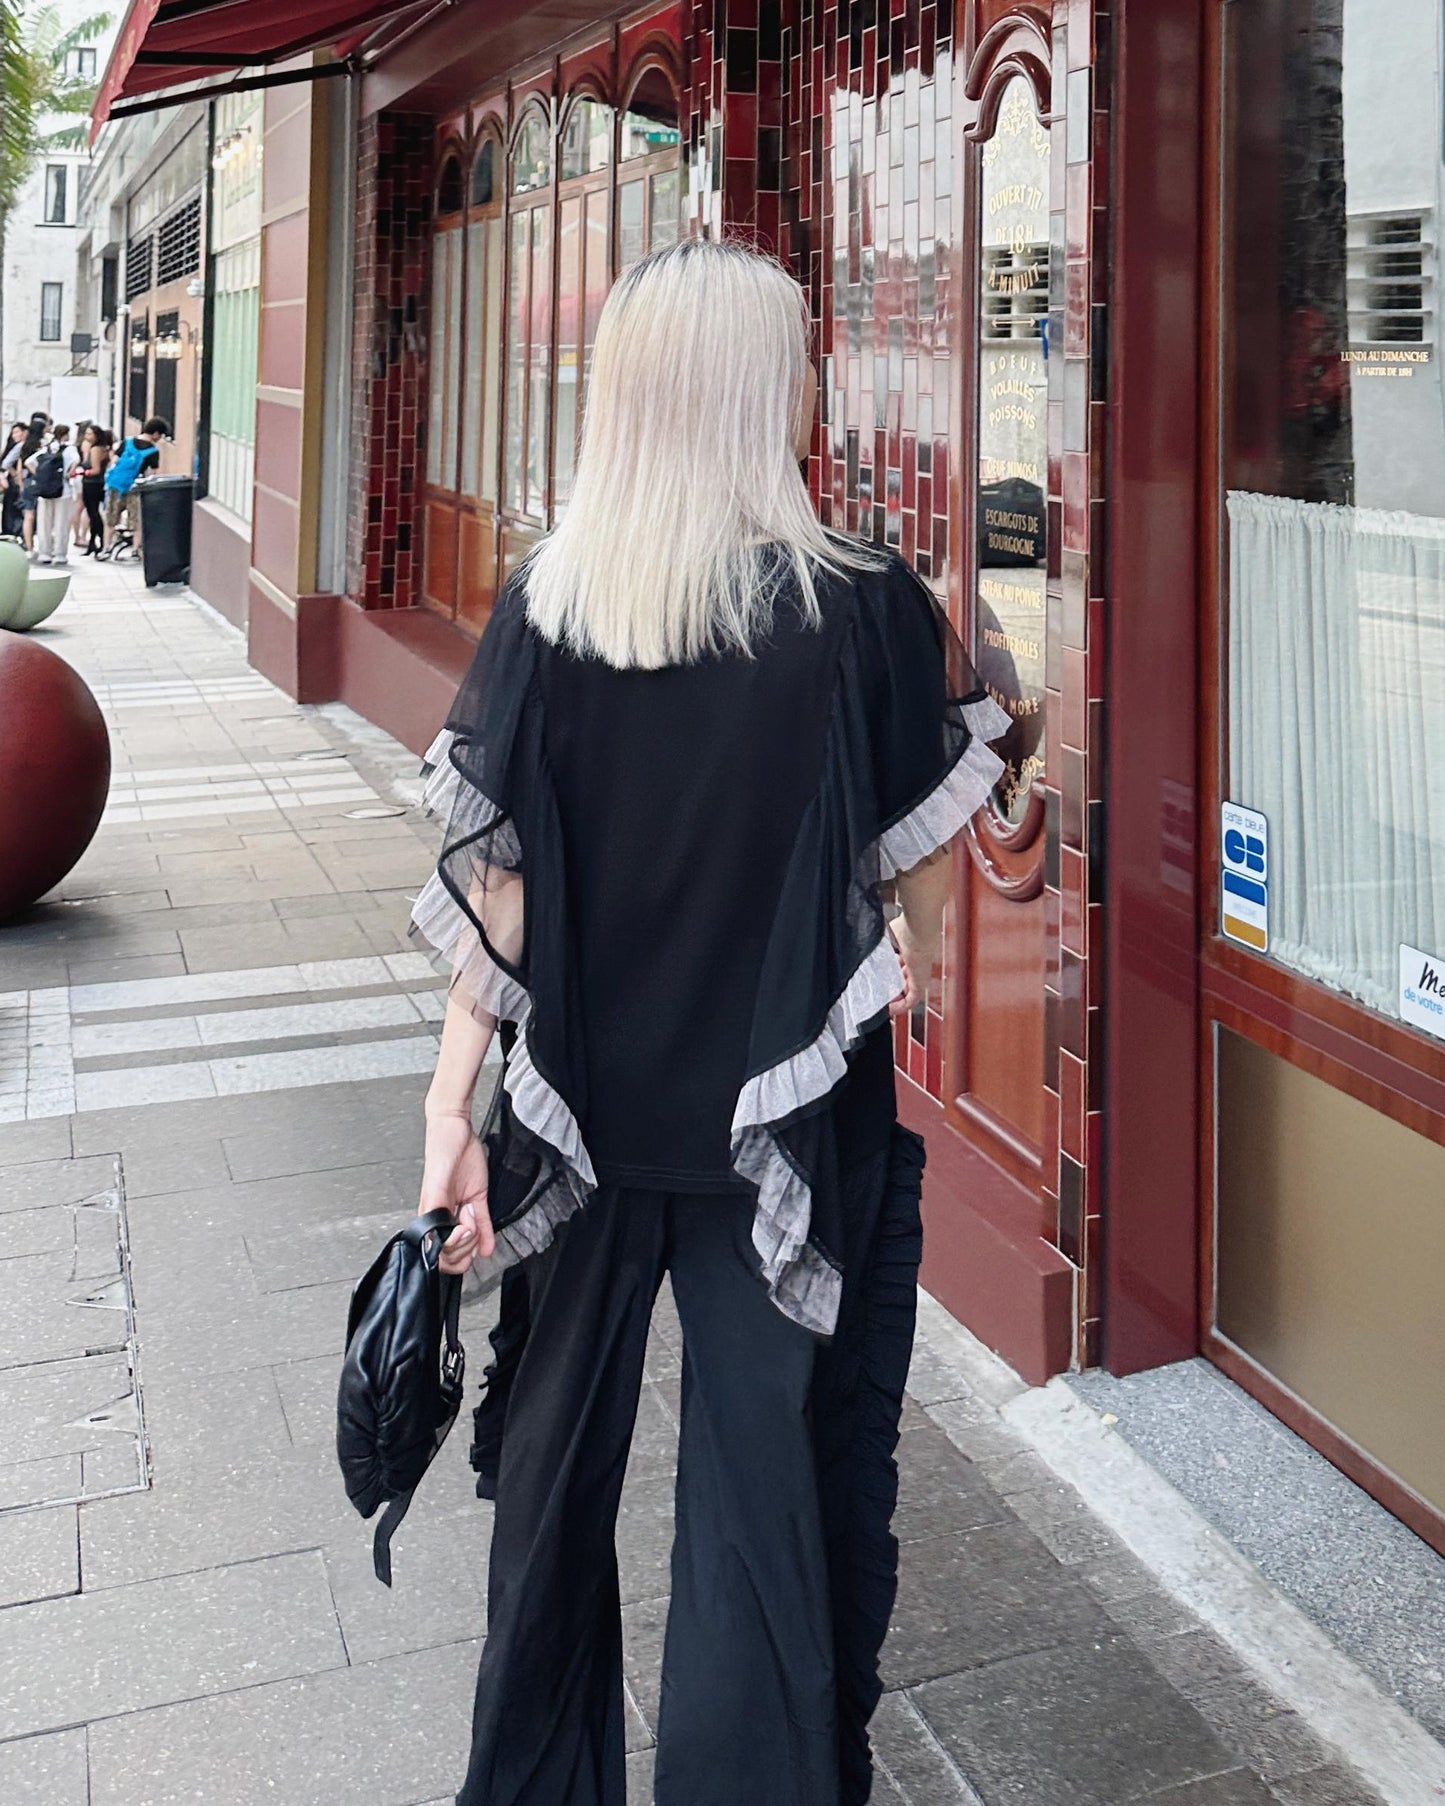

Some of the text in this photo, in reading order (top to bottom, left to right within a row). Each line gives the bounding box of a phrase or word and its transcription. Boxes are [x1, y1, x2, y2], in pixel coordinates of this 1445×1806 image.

[989, 184, 1026, 216] OUVERT
[995, 226, 1007, 244] DE
[999, 261, 1040, 296] MINUIT
[989, 354, 1037, 376] BOEUF
[1341, 350, 1429, 362] LUNDI AU DIMANCHE
[1361, 366, 1387, 377] PARTIR
[1387, 367, 1398, 377] DE
[990, 378, 1035, 403] VOLAILLES
[989, 404, 1037, 430] POISSONS
[985, 508, 1039, 534] ESCARGOTS DE
[988, 532, 1035, 557] BOURGOGNE
[981, 579, 1041, 609] STEAK AU POIVRE
[984, 628, 1039, 660] PROFITEROLES
[984, 681, 1039, 716] AND MORE
[1224, 810, 1265, 834] carte bleue
[1404, 987, 1444, 1015] de votre
